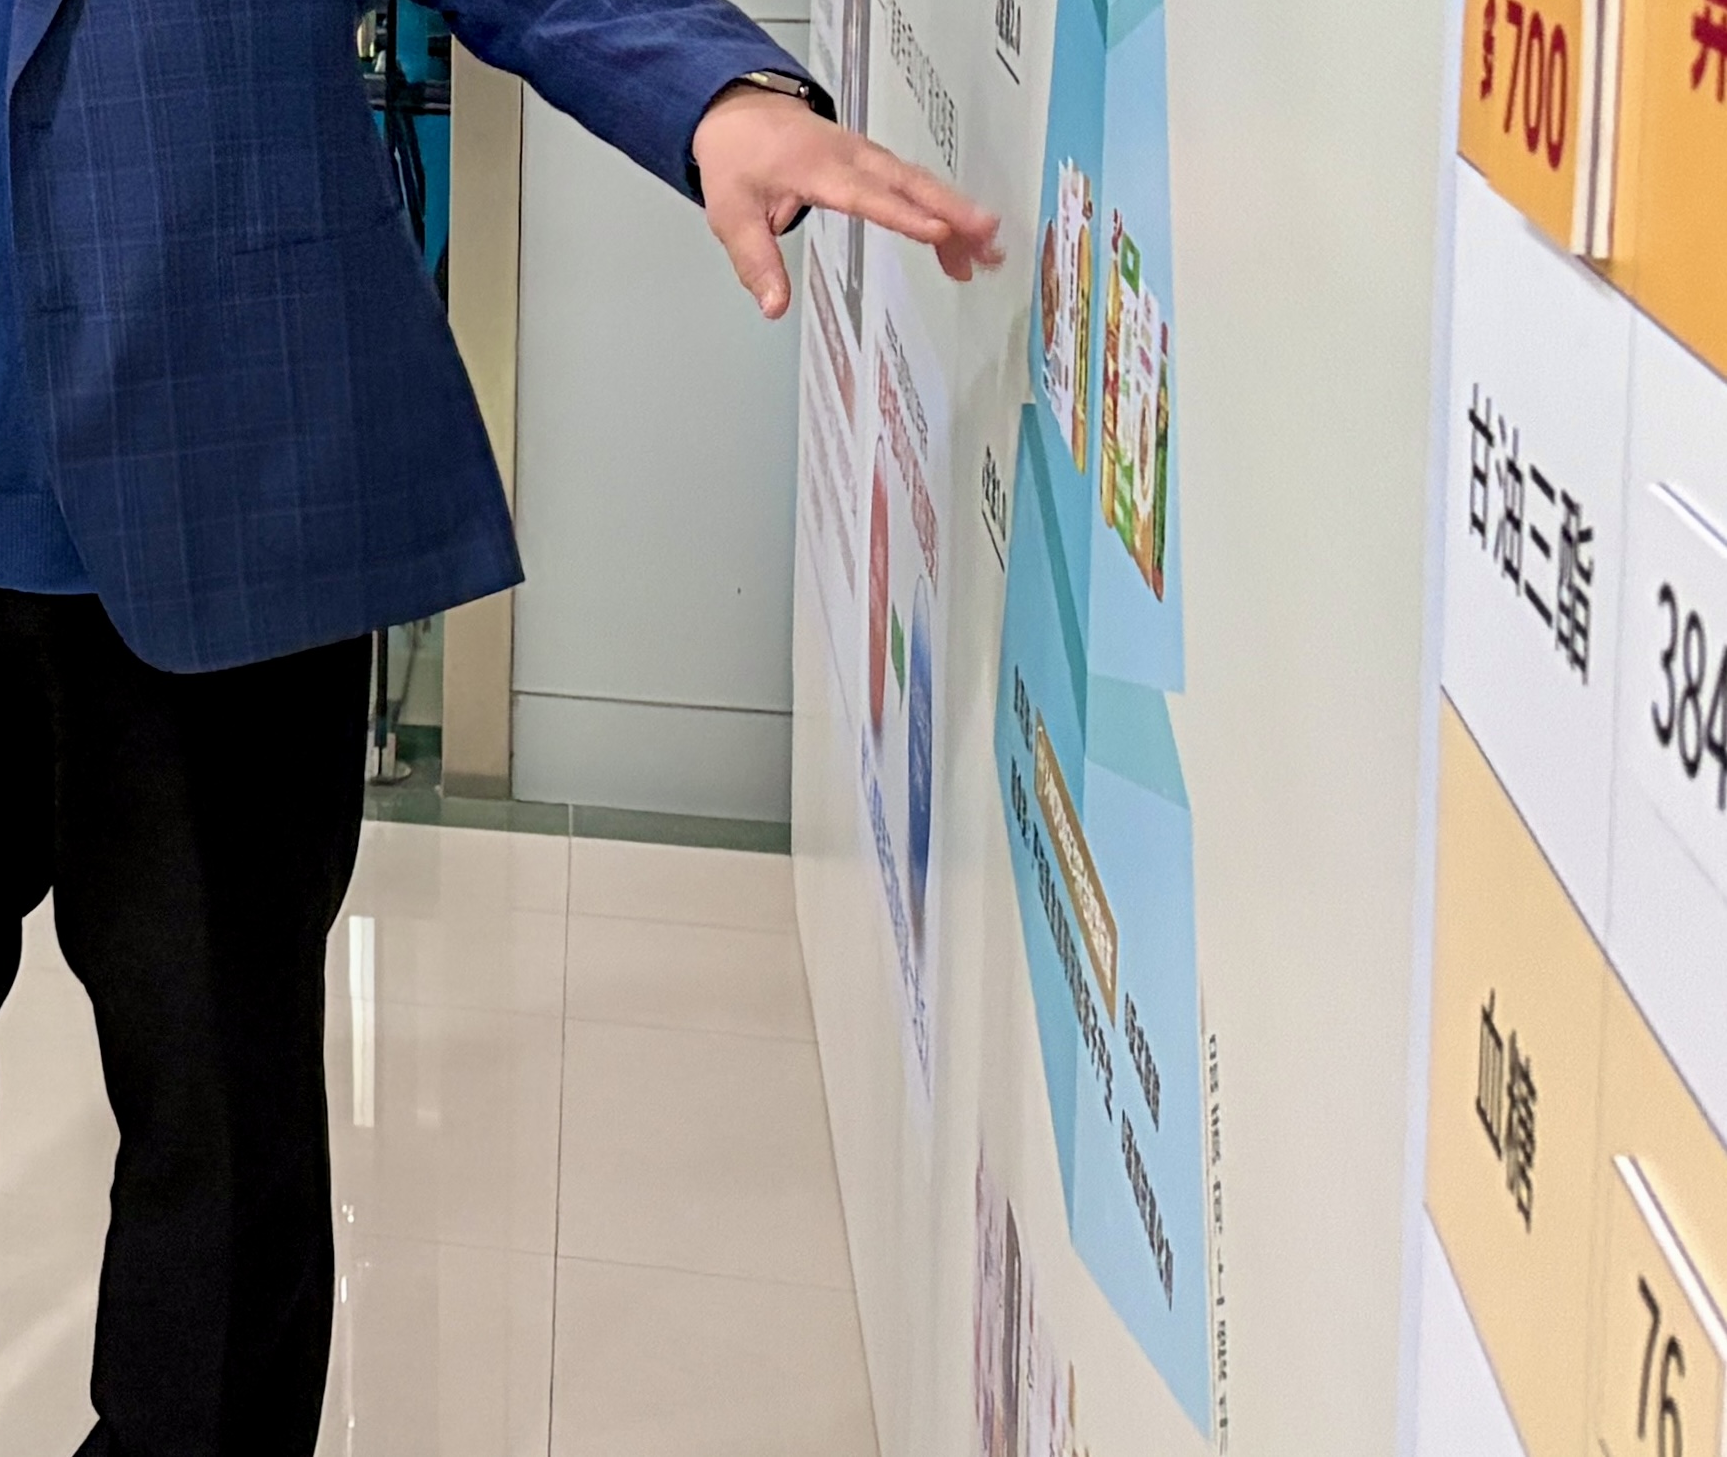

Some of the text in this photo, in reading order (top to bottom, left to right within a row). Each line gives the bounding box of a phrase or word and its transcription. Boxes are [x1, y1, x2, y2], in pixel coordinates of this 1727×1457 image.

[1503, 0, 1569, 173] 700
[1468, 381, 1595, 687] 甘油三酯
[1475, 987, 1538, 1235] 血糖
